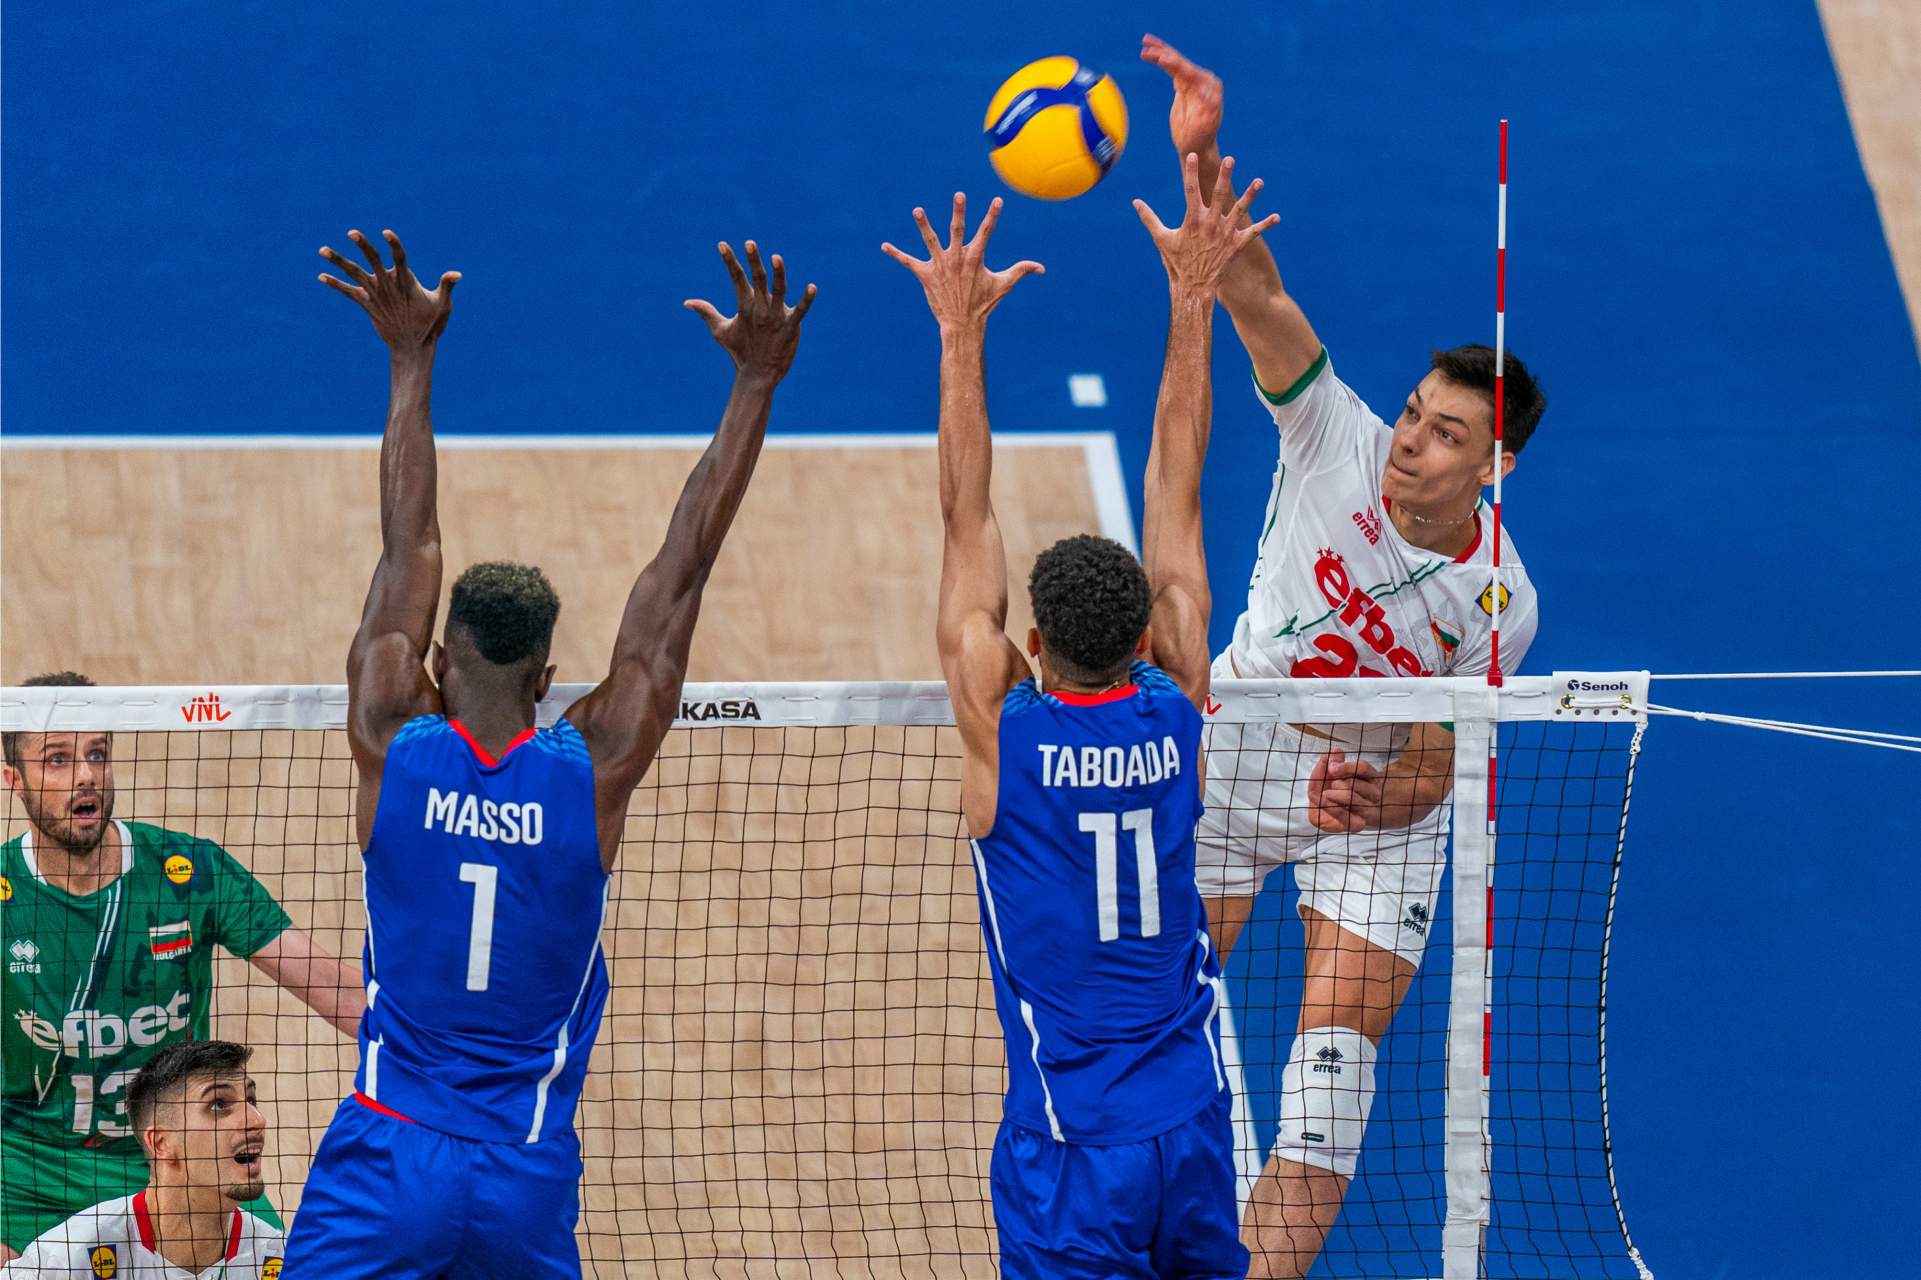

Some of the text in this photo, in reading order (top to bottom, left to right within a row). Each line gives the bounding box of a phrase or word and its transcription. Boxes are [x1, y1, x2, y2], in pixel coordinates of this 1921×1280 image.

[1352, 511, 1379, 546] errea
[1314, 558, 1434, 677] efbe
[181, 691, 231, 722] VNL
[1581, 681, 1628, 691] Senoh
[1038, 735, 1180, 788] TABOADA
[424, 787, 543, 845] MASSO
[1078, 808, 1160, 942] 11
[459, 862, 498, 992] 1
[20, 990, 190, 1059] efbet
[1313, 1064, 1341, 1074] errea
[71, 1068, 141, 1137] 13
